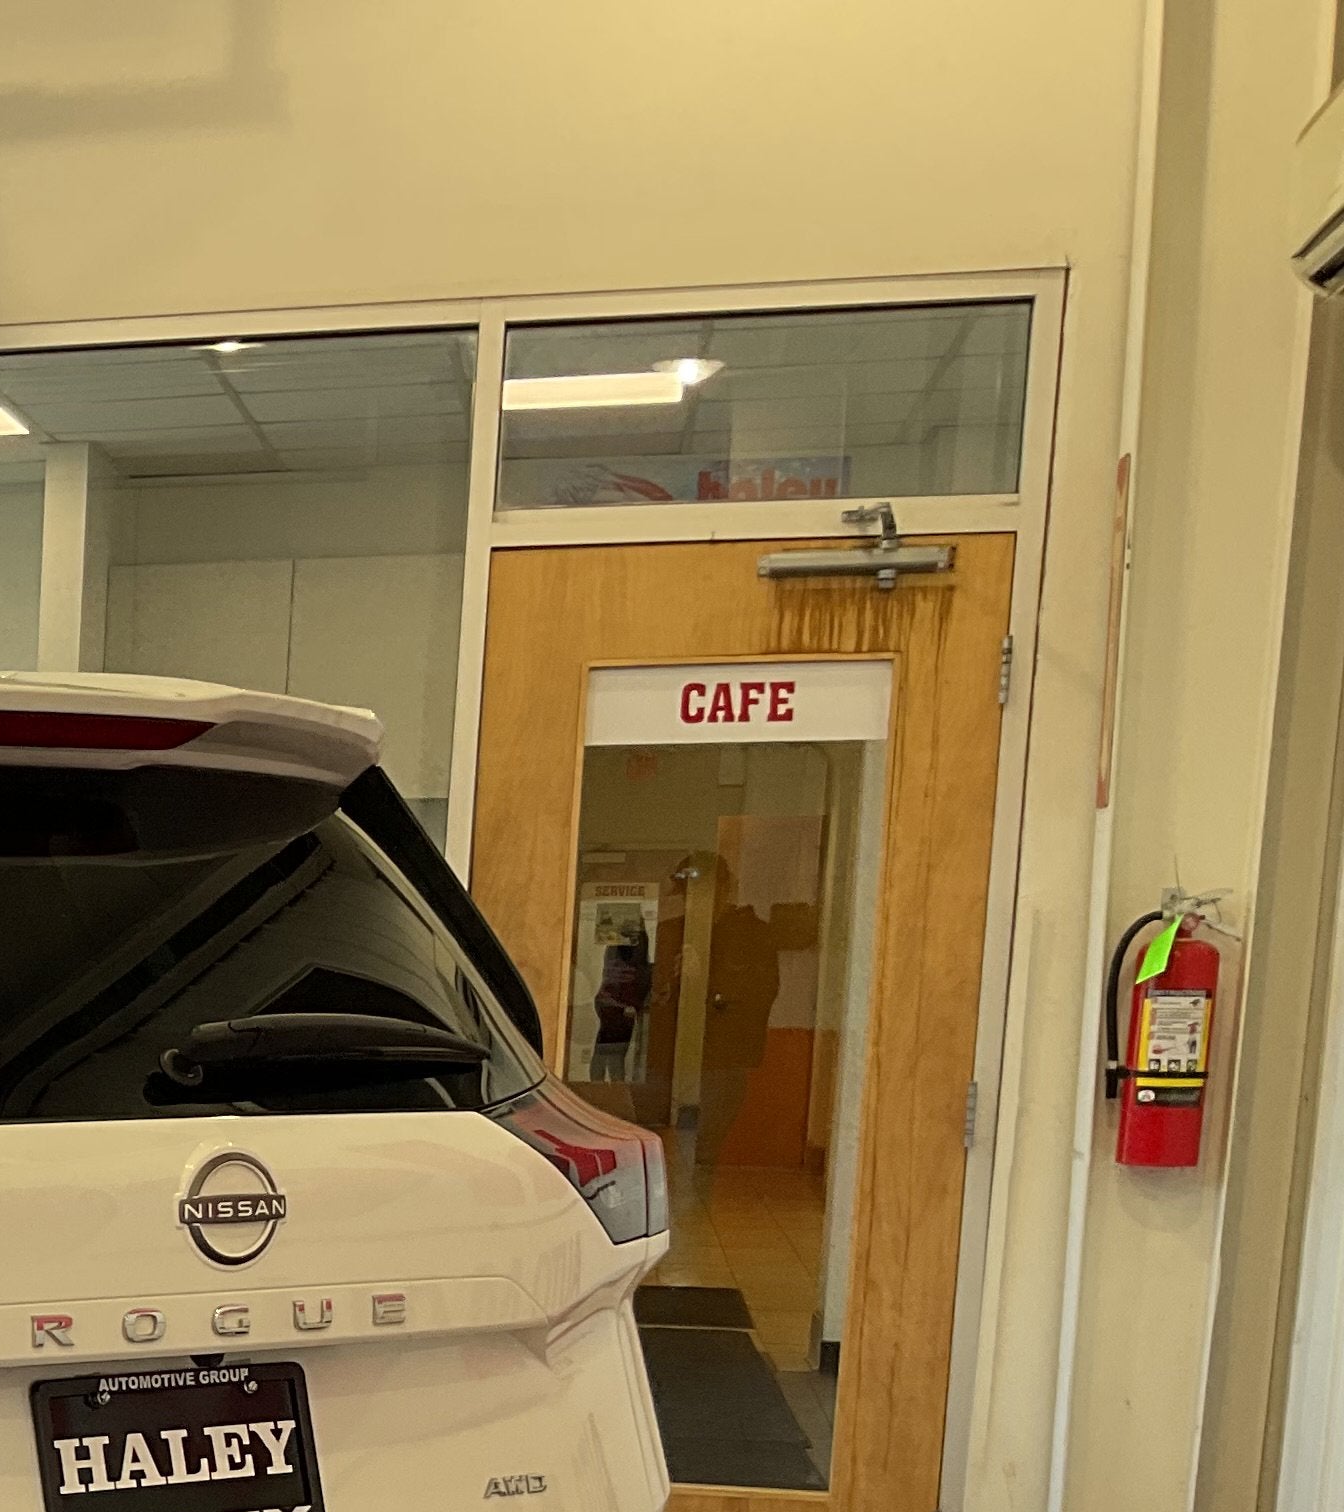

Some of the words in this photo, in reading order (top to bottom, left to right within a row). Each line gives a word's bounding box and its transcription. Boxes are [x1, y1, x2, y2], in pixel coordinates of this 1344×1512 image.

[680, 681, 796, 724] CAFE
[595, 885, 646, 897] SERVICE
[183, 1198, 285, 1221] NISSAN
[31, 1293, 407, 1348] ROGUE
[98, 1370, 196, 1393] AUTOMOTIVE
[198, 1367, 250, 1384] GROUP
[53, 1419, 297, 1495] HALEY
[483, 1474, 548, 1499] AWD
